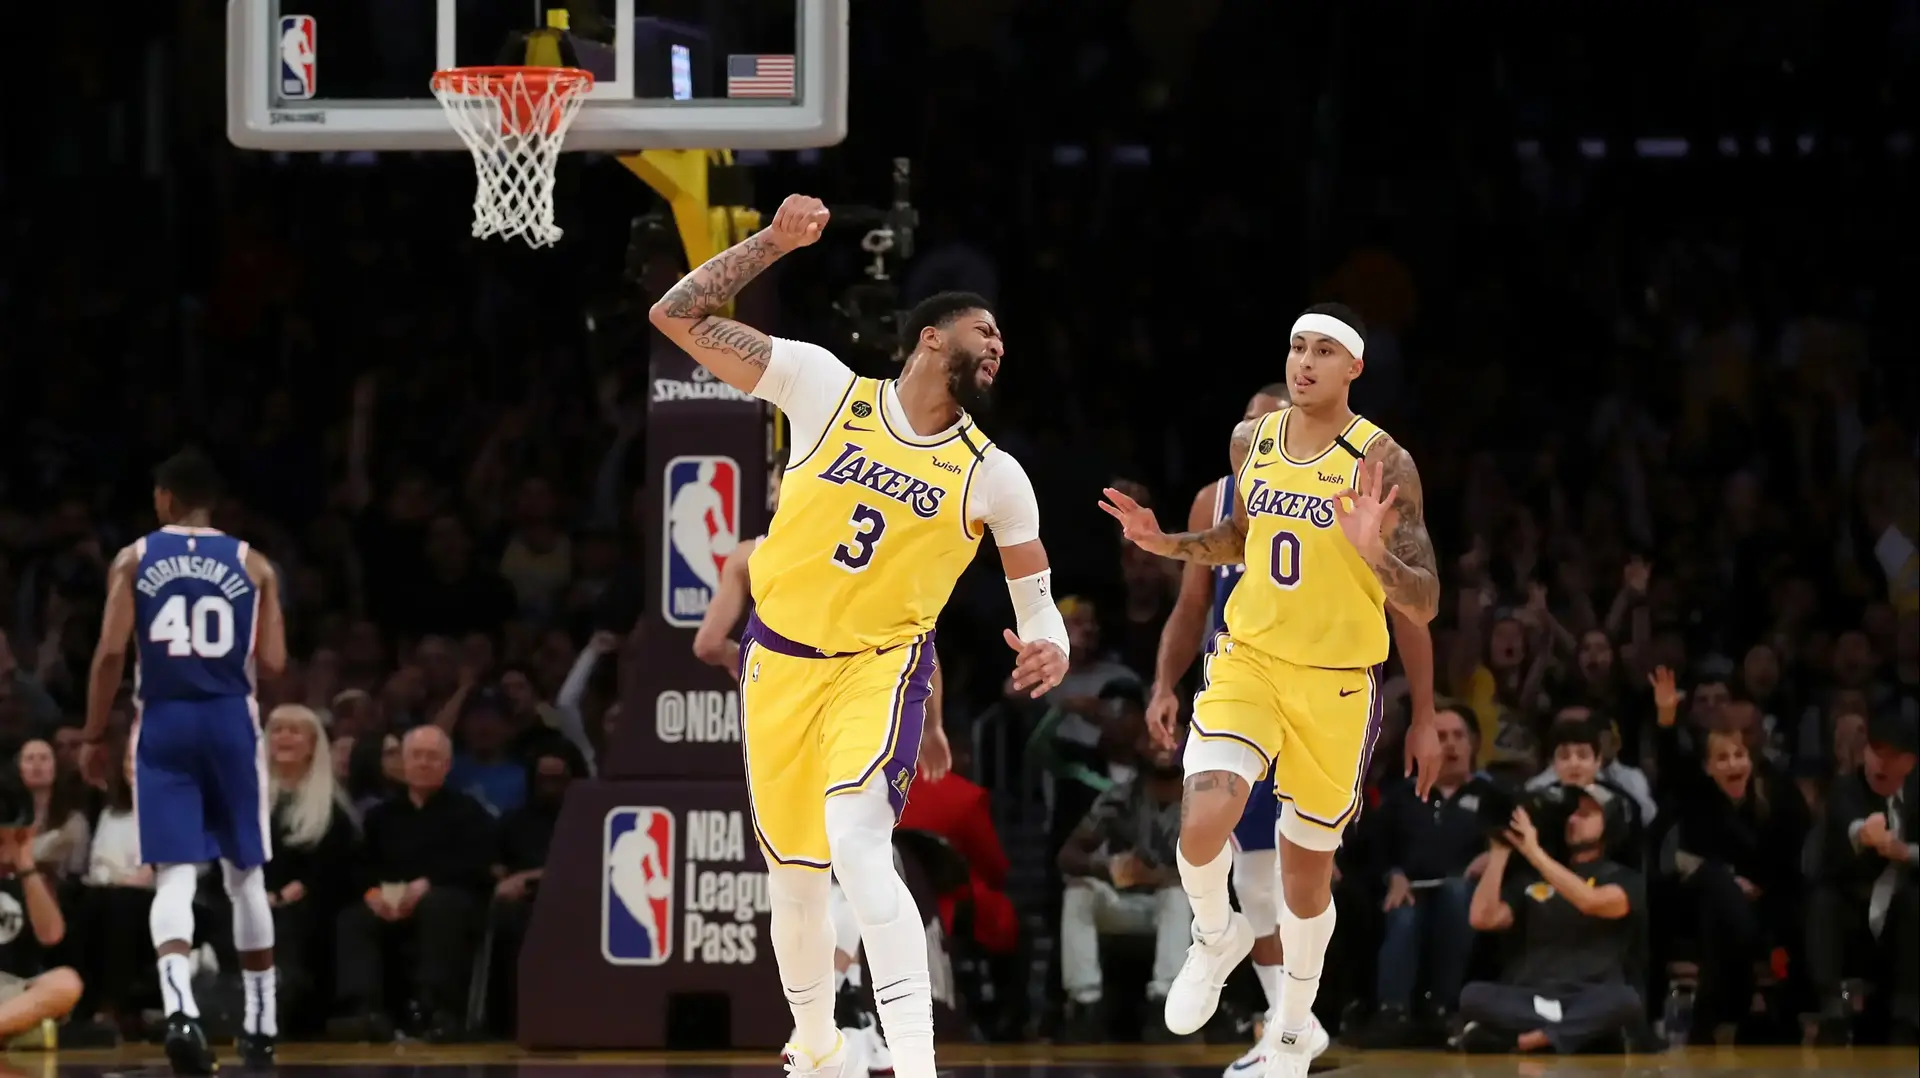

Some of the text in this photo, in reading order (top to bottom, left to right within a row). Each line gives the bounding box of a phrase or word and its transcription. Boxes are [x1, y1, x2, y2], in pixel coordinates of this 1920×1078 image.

[817, 441, 947, 519] LAKERS
[932, 455, 962, 475] wish
[1317, 471, 1344, 485] wish
[1247, 478, 1335, 529] LAKERS
[830, 502, 887, 573] 3
[1270, 530, 1301, 588] 0
[136, 555, 250, 601] ROBINSON III
[674, 586, 712, 616] NBA
[148, 593, 235, 659] 40
[655, 690, 740, 744] @NBA
[685, 809, 746, 862] NBA
[683, 912, 758, 965] Pass
